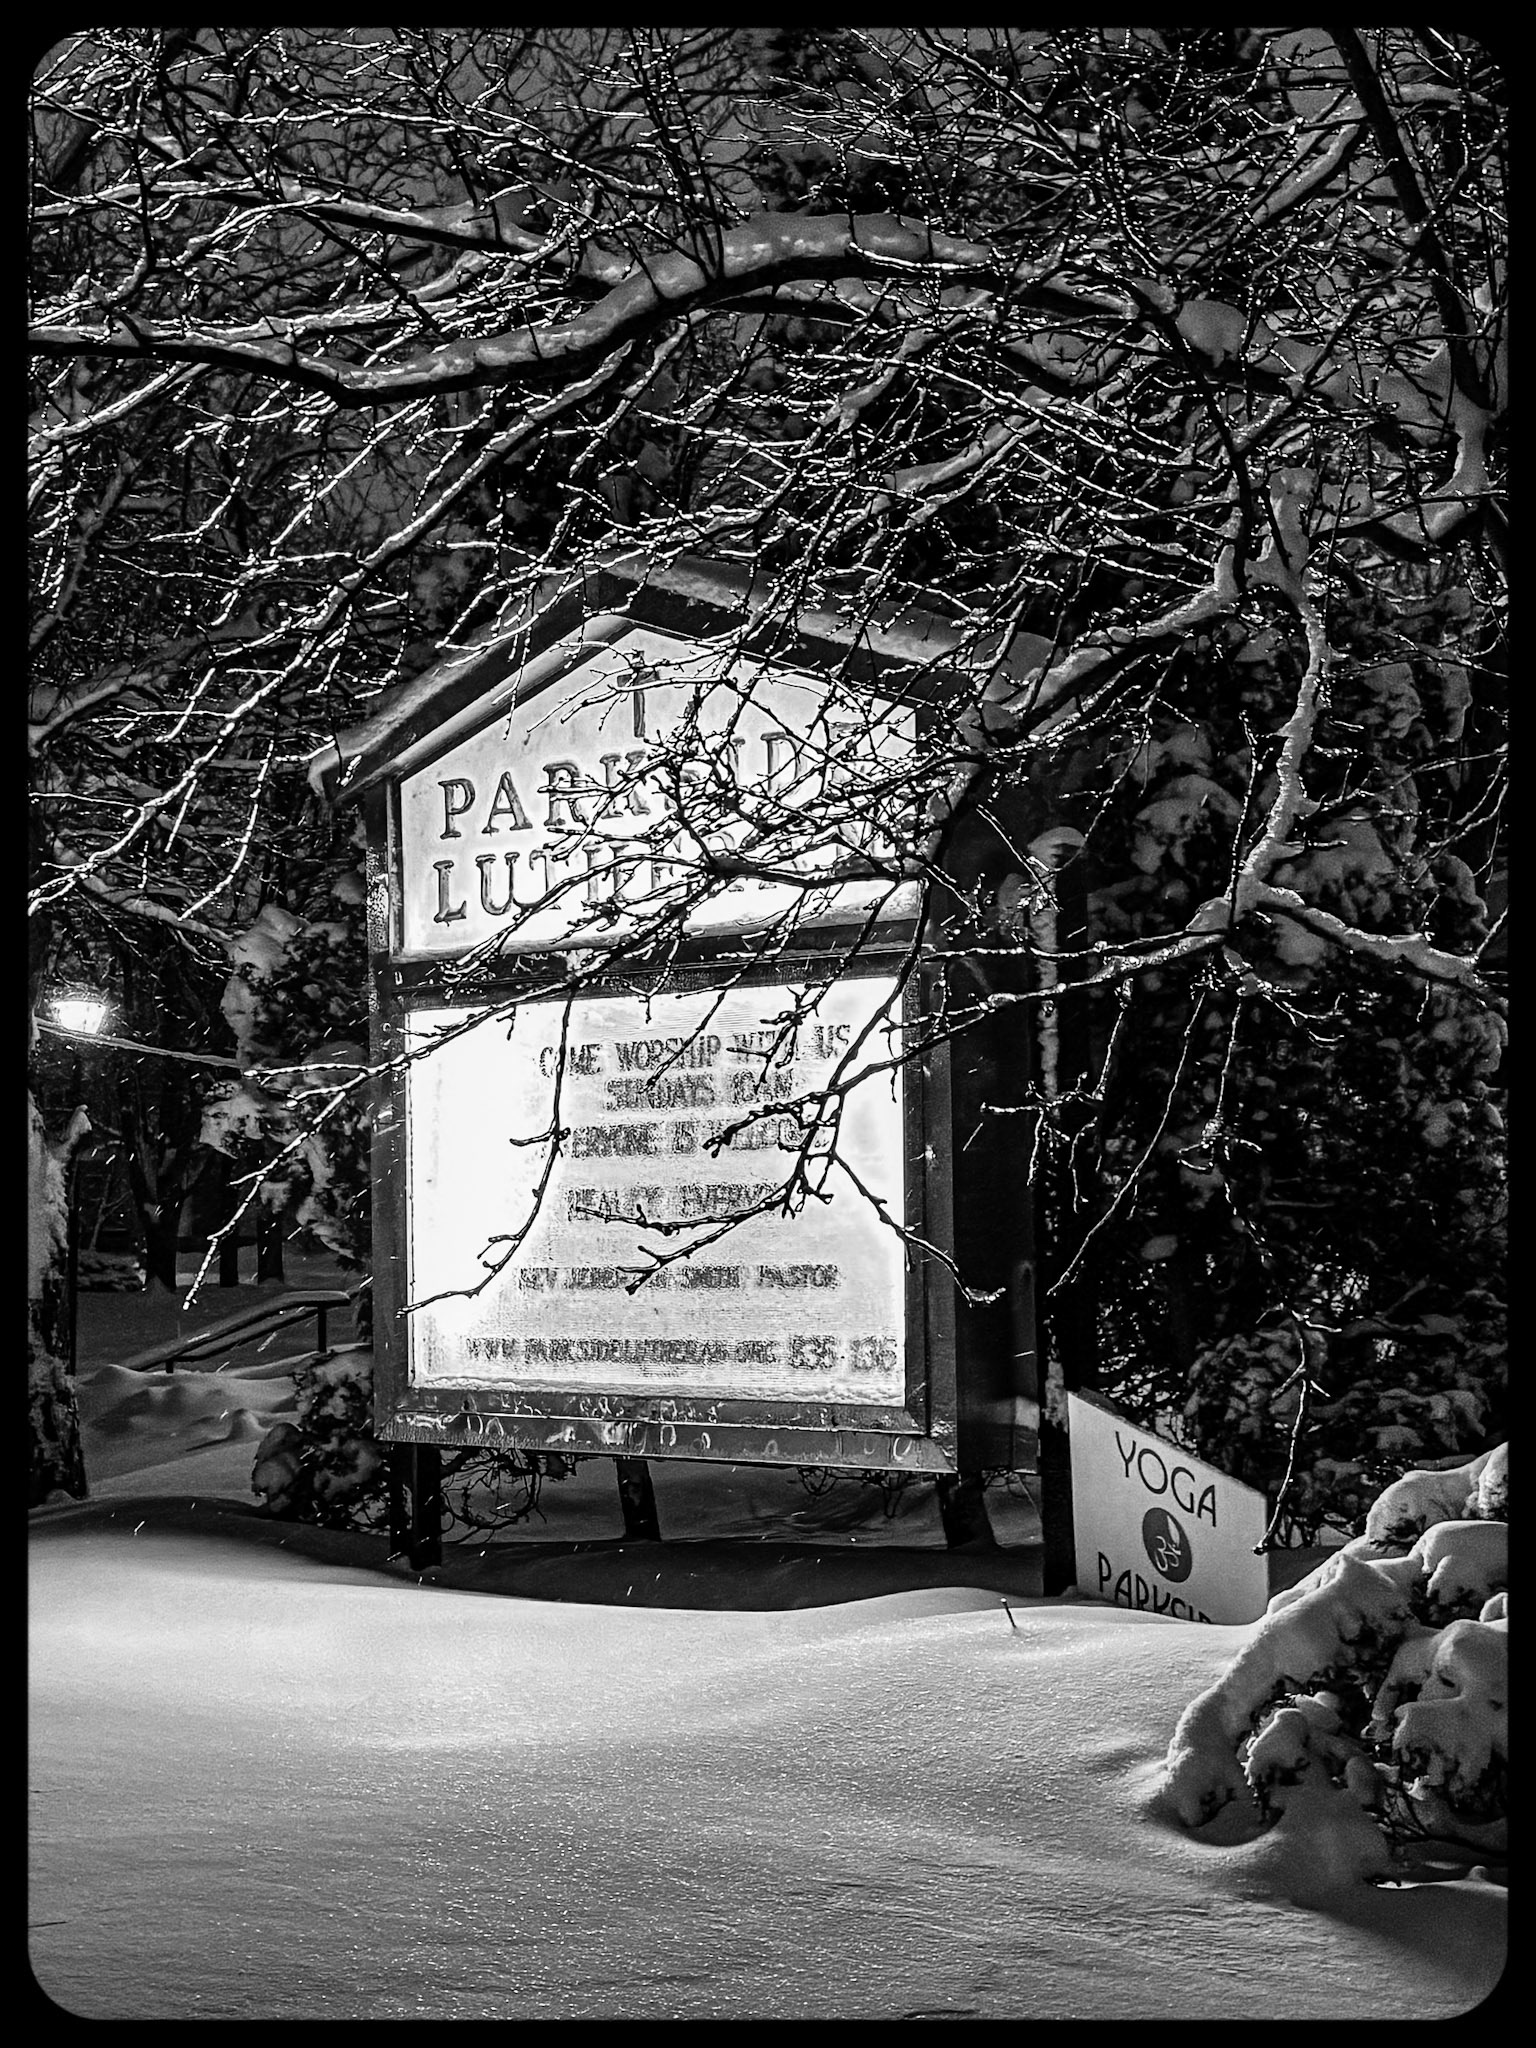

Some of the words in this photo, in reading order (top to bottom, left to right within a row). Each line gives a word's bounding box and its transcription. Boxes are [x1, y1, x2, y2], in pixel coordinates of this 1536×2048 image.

[539, 1043, 601, 1078] CME
[616, 1034, 721, 1071] WORSHIP
[814, 1024, 851, 1059] US
[1115, 1431, 1217, 1527] YOGA
